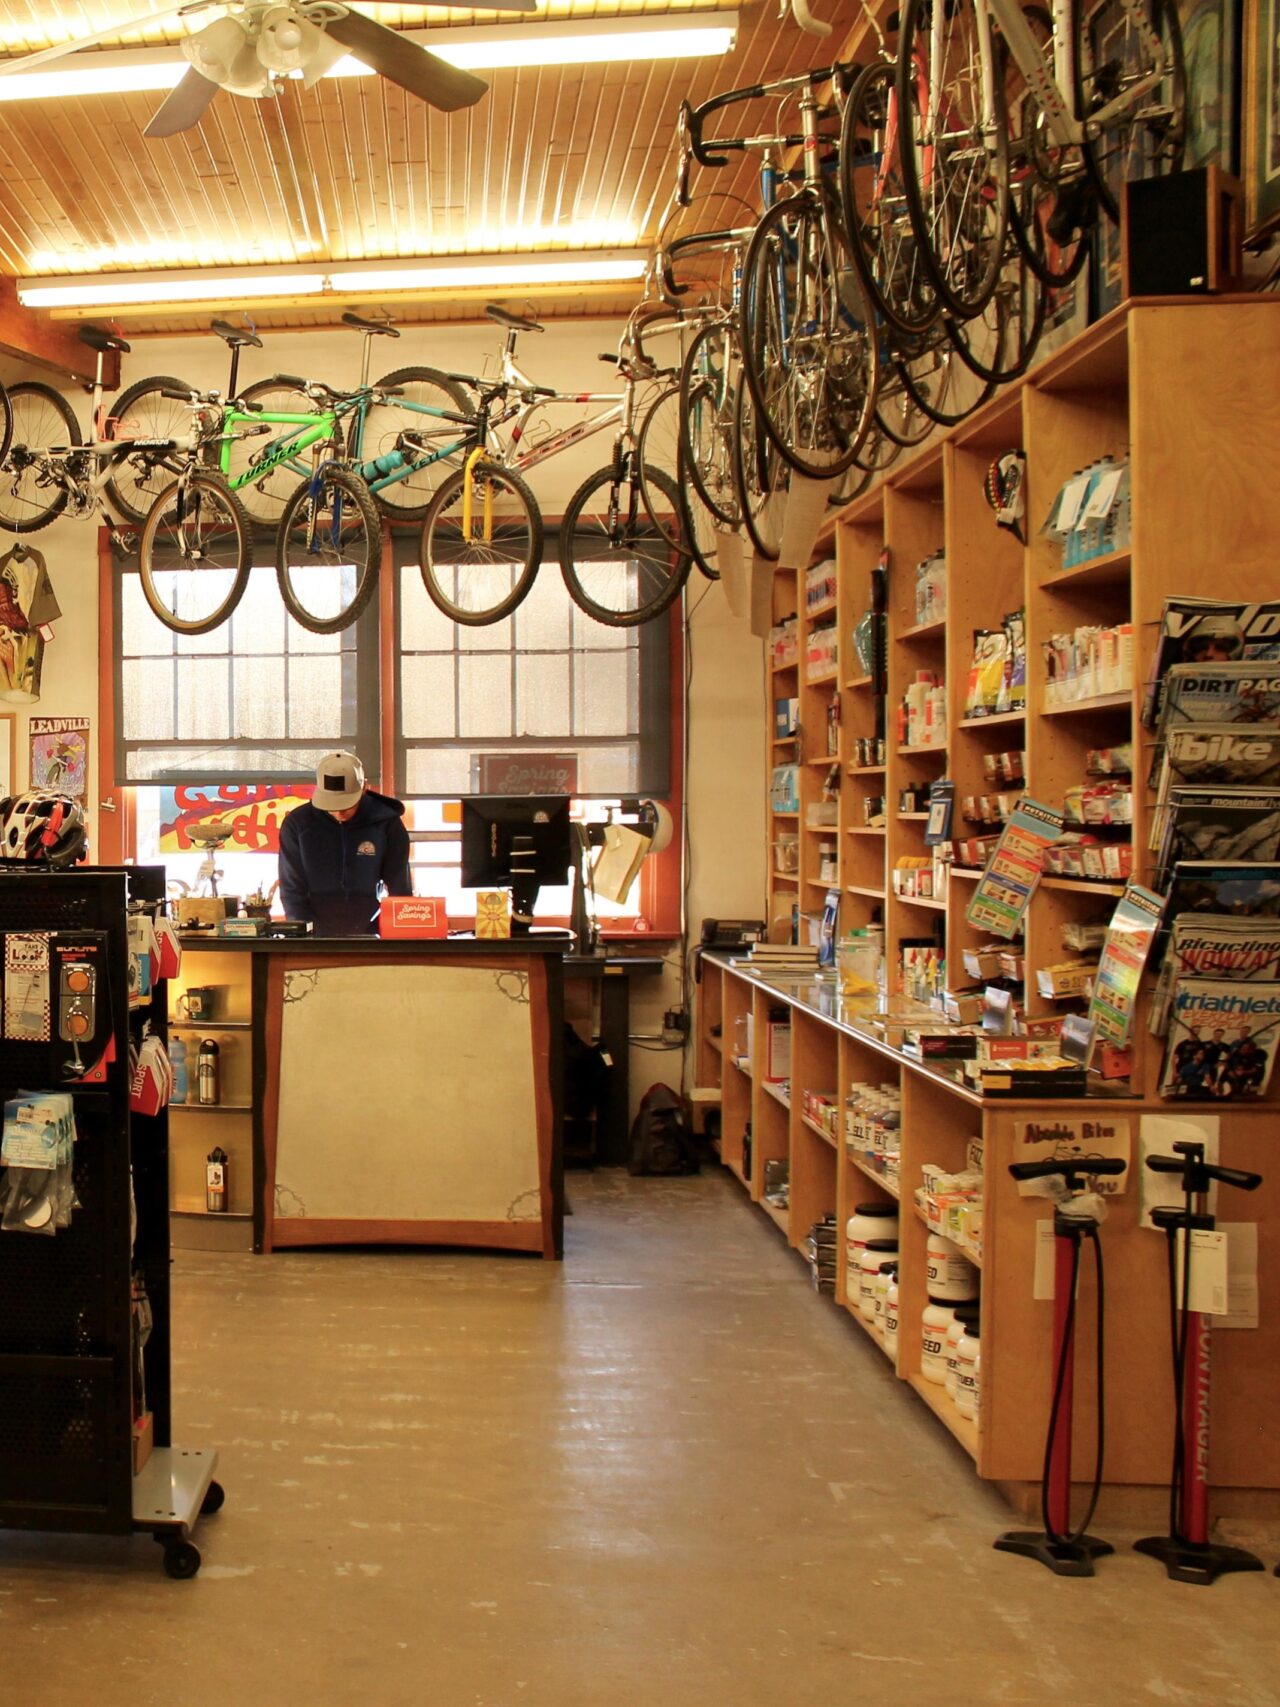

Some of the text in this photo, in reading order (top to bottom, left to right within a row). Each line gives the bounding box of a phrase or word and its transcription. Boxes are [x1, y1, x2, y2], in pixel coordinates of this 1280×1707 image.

[237, 441, 299, 487] TURNER
[410, 451, 440, 472] YETI
[1182, 679, 1236, 693] DIRT
[30, 719, 89, 734] LEADVILLE
[1177, 733, 1273, 761] bike
[505, 765, 570, 784] Spring
[397, 911, 432, 921] Savings
[402, 904, 431, 914] Spring
[131, 1063, 148, 1099] SPORT
[1086, 1174, 1118, 1194] You
